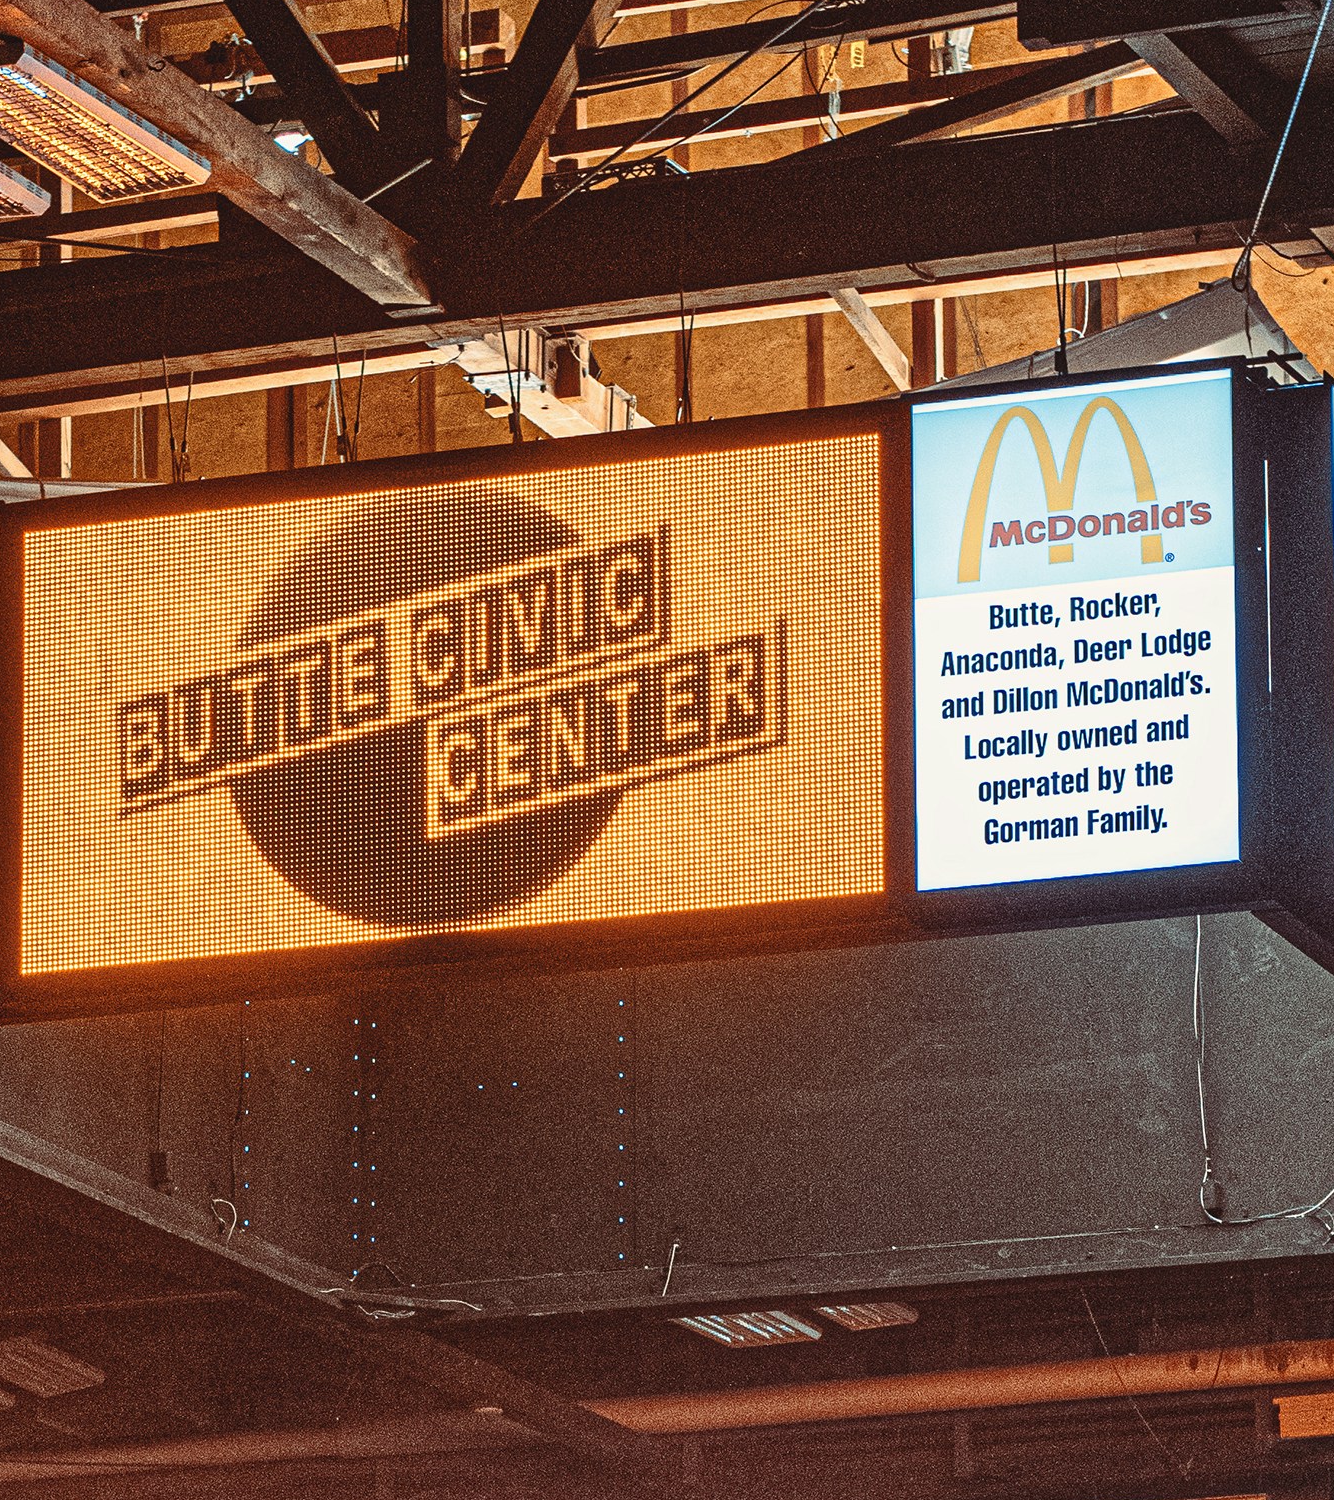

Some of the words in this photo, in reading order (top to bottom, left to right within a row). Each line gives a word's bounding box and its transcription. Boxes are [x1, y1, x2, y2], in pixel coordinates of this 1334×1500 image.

[989, 500, 1212, 549] McDonald's
[989, 603, 1061, 630] Butte,
[1070, 591, 1161, 622] Rocker,
[118, 622, 392, 797] BUTTE
[409, 532, 657, 702] CIVIC
[940, 643, 1064, 677] Anaconda,
[1073, 635, 1133, 663] Deer
[1140, 630, 1212, 658] Lodge
[941, 691, 984, 720] and
[993, 684, 1058, 713] Dillon
[1066, 671, 1210, 708] McDonald's.
[432, 632, 770, 822] CENTER
[964, 729, 1047, 761] Locally
[1057, 720, 1138, 750] owned
[1146, 714, 1190, 743] and
[977, 769, 1090, 804] operated
[1097, 764, 1126, 794] by
[1134, 761, 1173, 787] the
[983, 811, 1079, 845] Gorman
[1086, 804, 1167, 836] Family.
